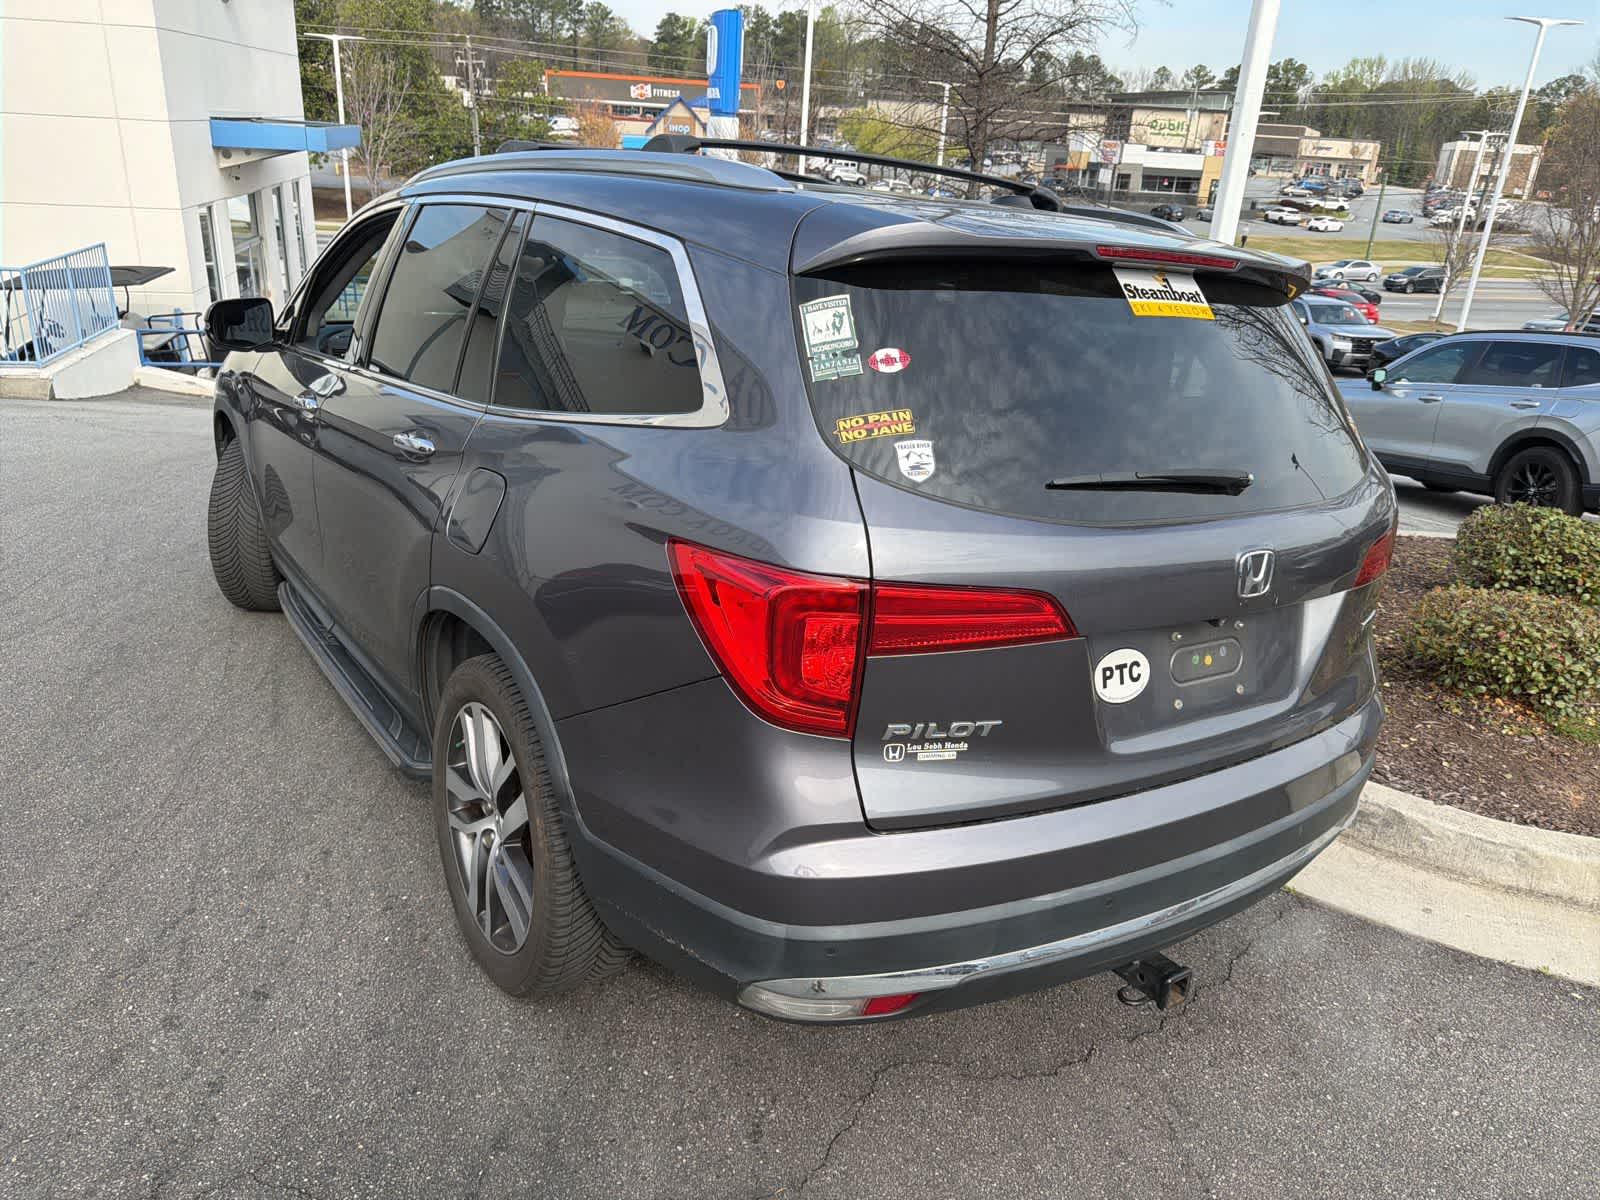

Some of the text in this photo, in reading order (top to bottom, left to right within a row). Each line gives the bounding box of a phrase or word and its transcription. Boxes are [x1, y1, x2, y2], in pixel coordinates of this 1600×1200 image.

[1123, 278, 1204, 303] Steamboat
[807, 303, 824, 312] HAVE
[823, 299, 847, 309] VISITED
[815, 358, 858, 371] TANZANIA
[838, 411, 911, 430] NO PAIN
[840, 422, 913, 441] NO JANE
[1102, 661, 1142, 689] PTC
[881, 720, 1003, 740] PILOT
[945, 741, 968, 749] Honda
